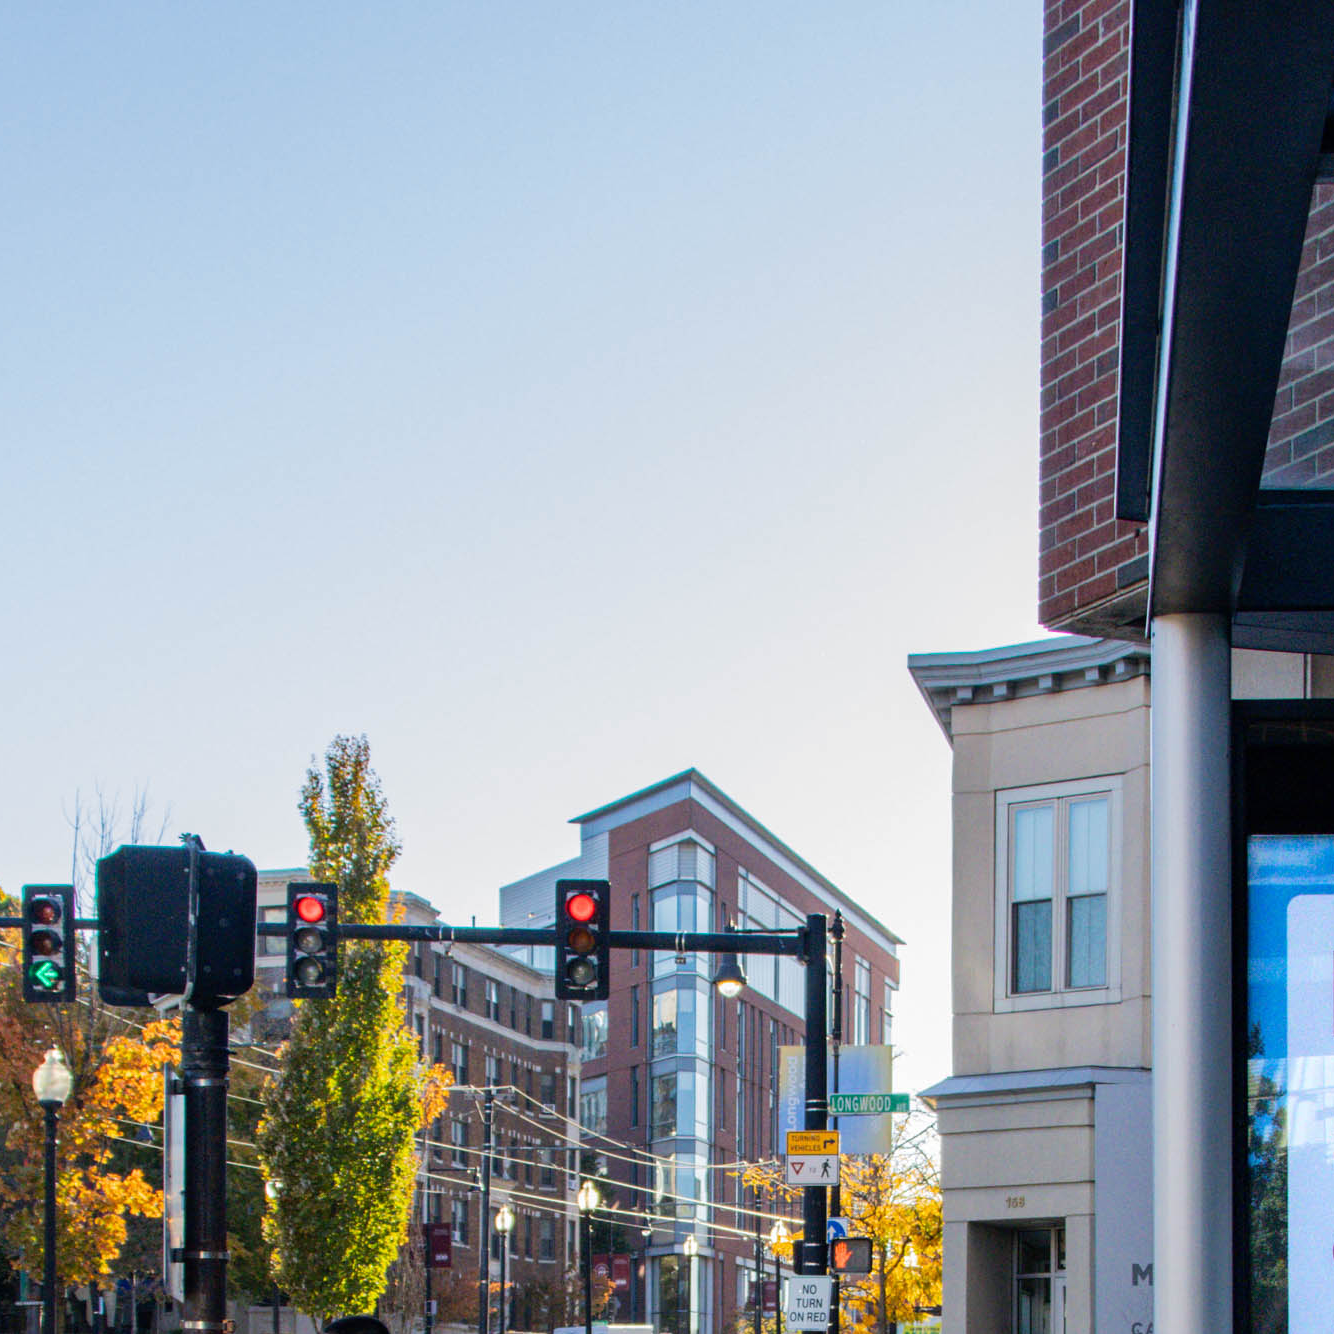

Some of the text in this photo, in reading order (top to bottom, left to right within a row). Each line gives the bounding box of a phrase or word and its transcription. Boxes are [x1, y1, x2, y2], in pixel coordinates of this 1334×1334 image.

[786, 1056, 798, 1132] Longwood
[832, 1096, 891, 1112] LONGWOOD
[802, 1285, 817, 1294] NO
[796, 1299, 823, 1308] TURN
[790, 1312, 826, 1322] ON RED
